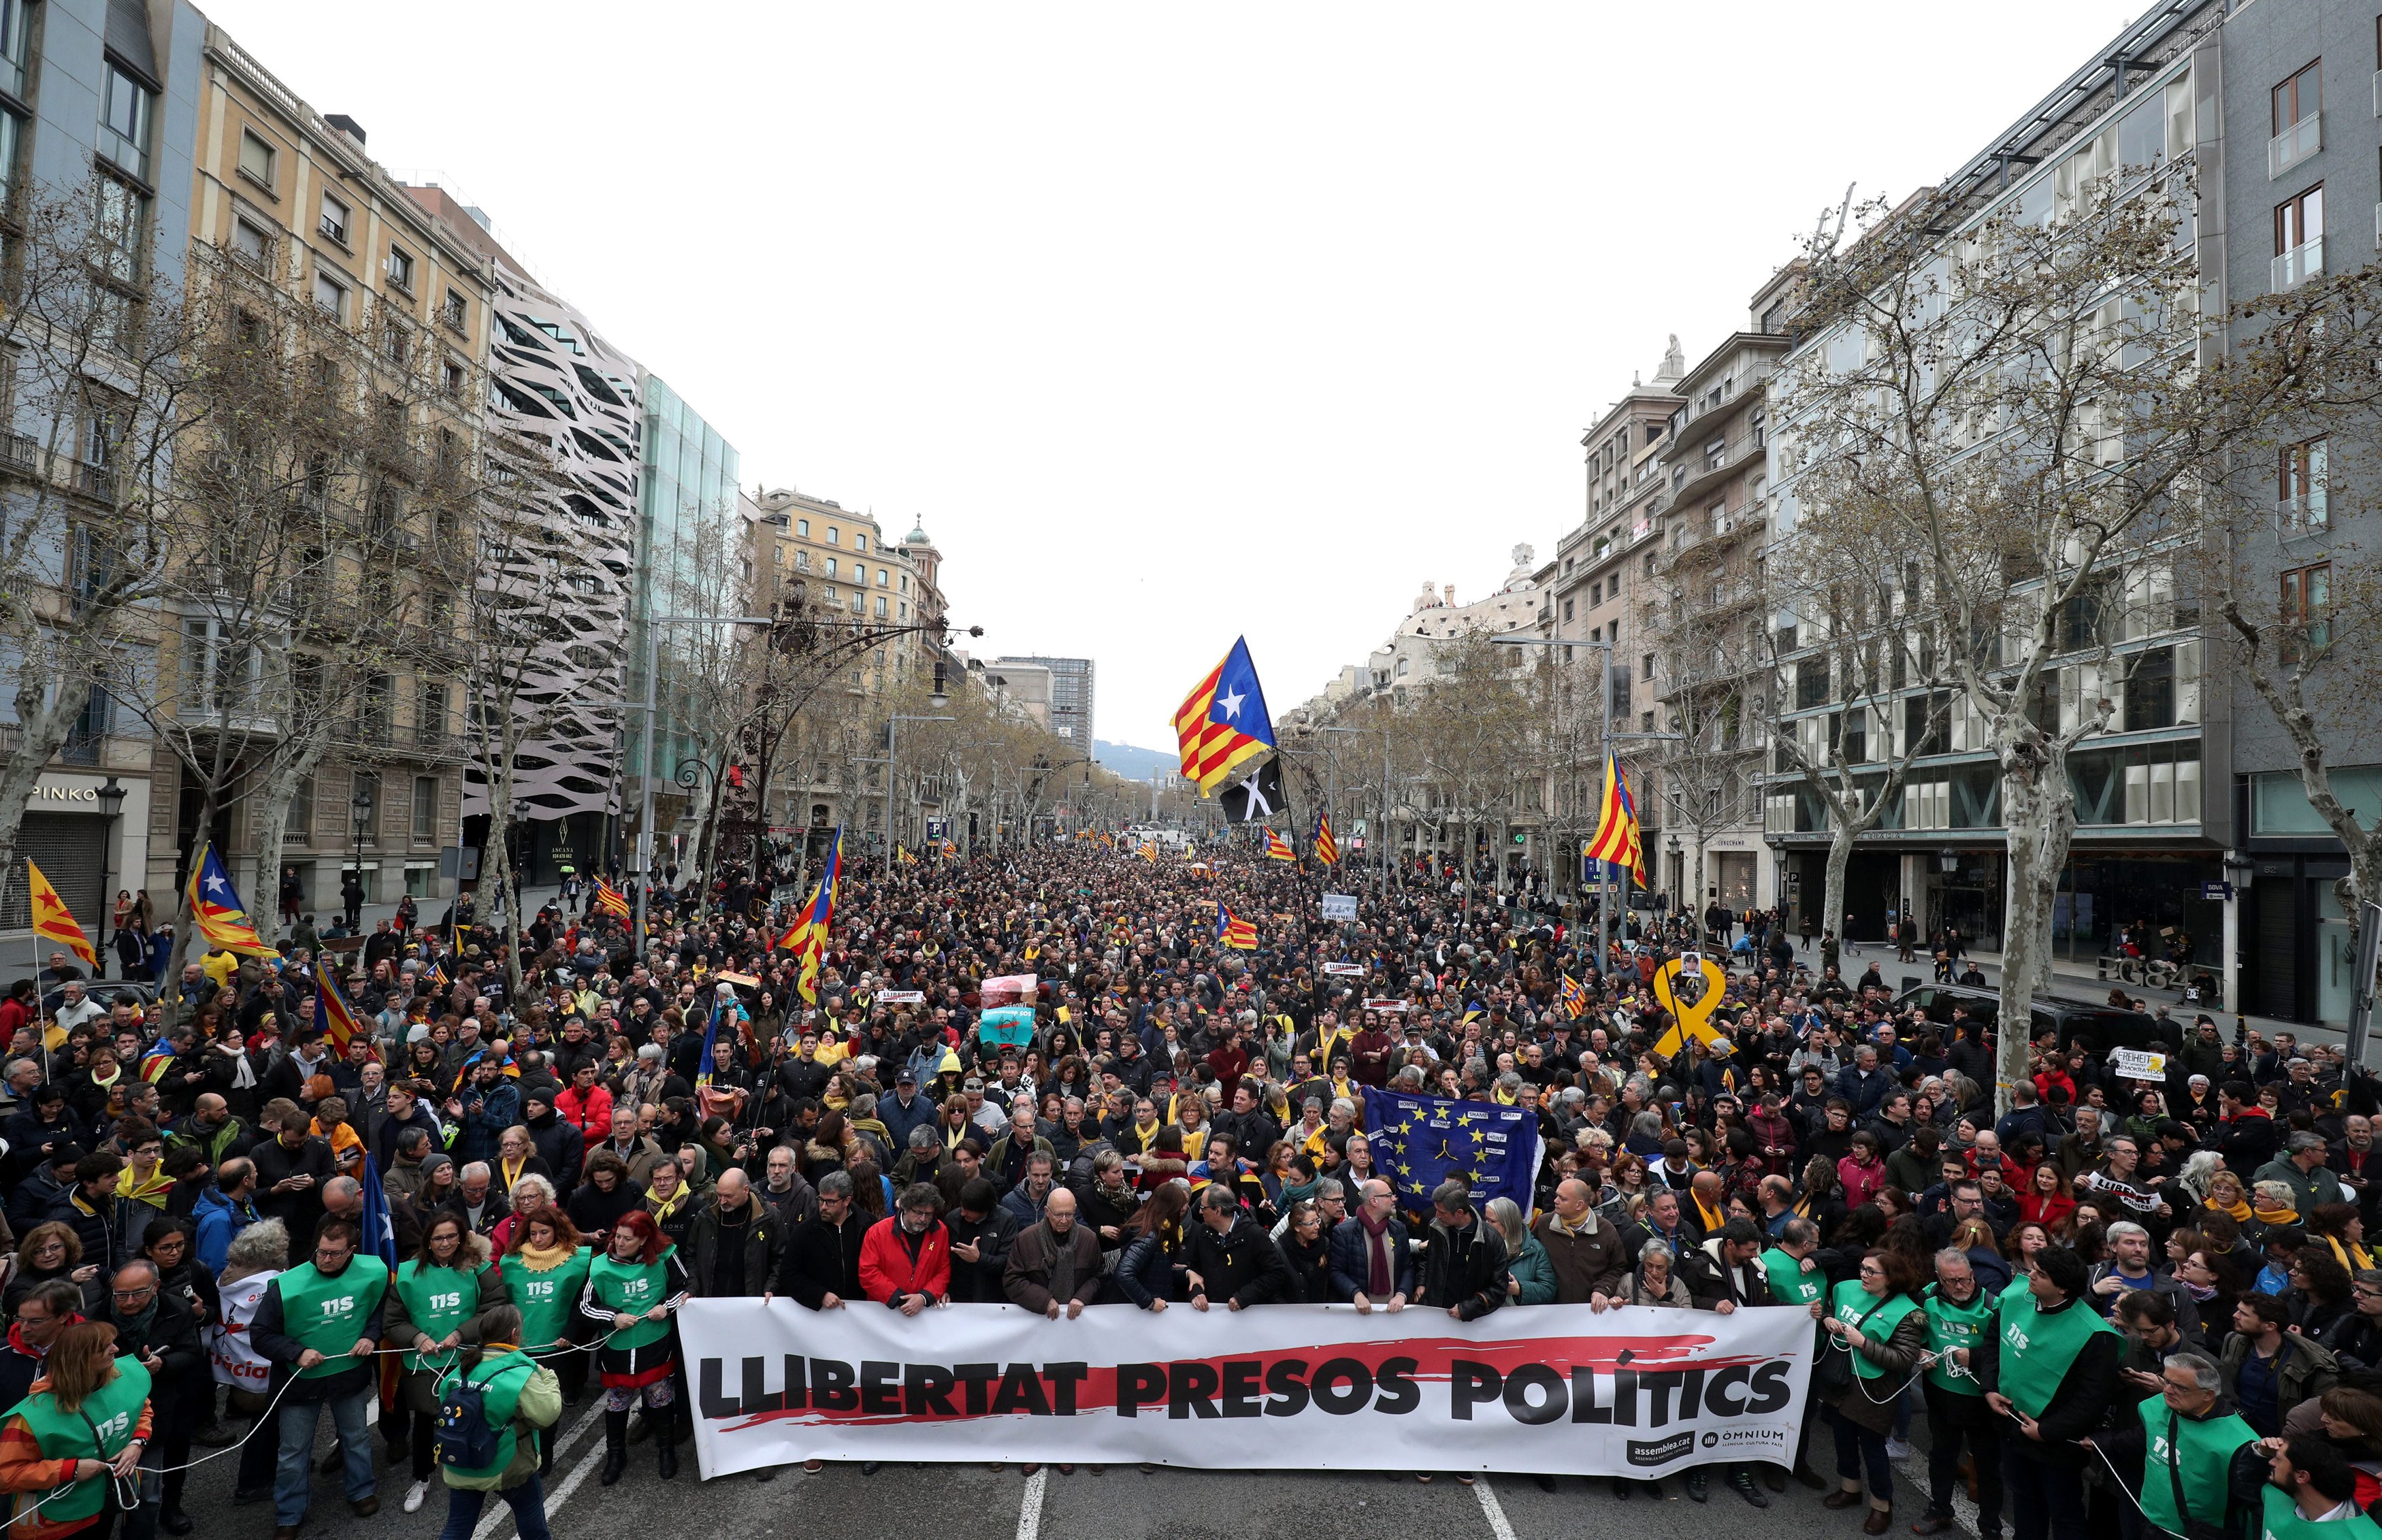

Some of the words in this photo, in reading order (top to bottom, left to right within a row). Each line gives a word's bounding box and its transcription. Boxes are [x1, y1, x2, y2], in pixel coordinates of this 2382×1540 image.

[33, 786, 97, 801] PINKO
[933, 823, 940, 833] P
[2118, 1051, 2153, 1064] FREIHEIT
[526, 1281, 554, 1296] 11S
[623, 1279, 649, 1294] 11S
[321, 1296, 355, 1315] 11S
[429, 1292, 461, 1309] 11S
[1940, 1317, 1970, 1335] 11S
[2007, 1322, 2029, 1349] 11S
[700, 1354, 1088, 1419] LLIBERTAT
[1117, 1356, 1421, 1419] PRESOS
[1451, 1347, 1792, 1428] POLÍTICS
[1723, 1430, 1784, 1441] ÒMNIUM
[1635, 1437, 1691, 1456] assemblea.cat
